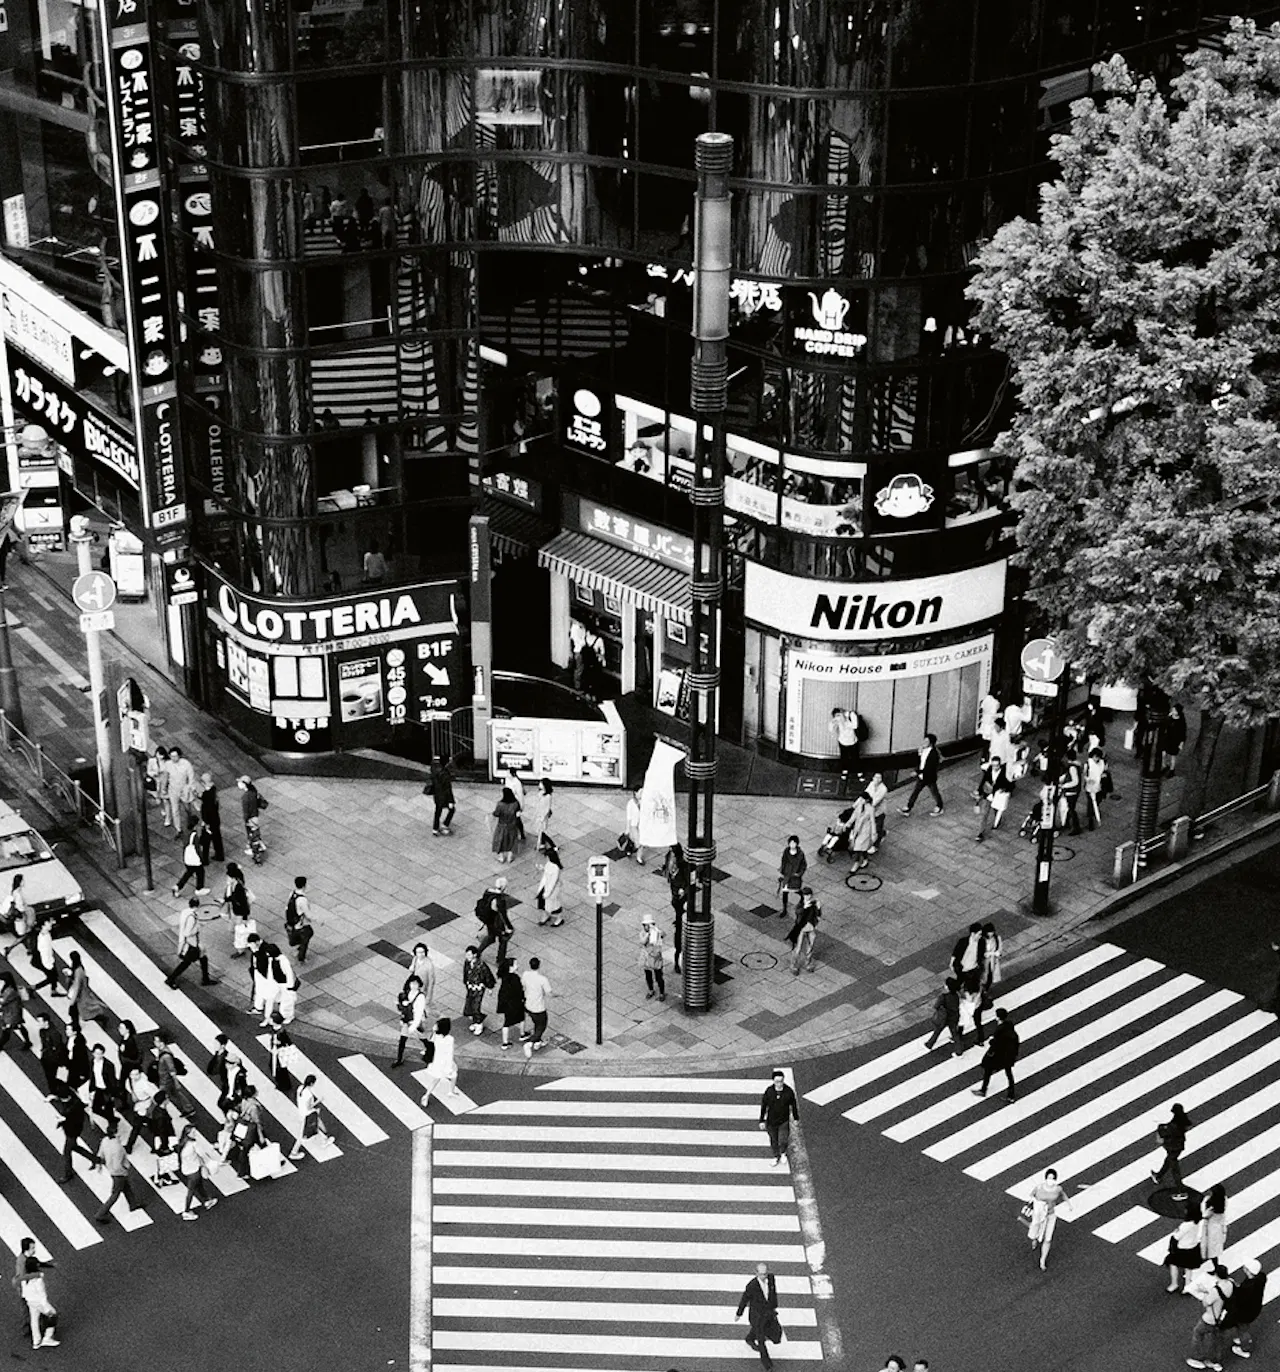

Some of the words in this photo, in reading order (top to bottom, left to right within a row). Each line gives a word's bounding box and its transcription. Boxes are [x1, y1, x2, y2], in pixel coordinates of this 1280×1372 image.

[119, 76, 134, 148] レストラン
[131, 70, 152, 144] 不二家
[135, 233, 165, 344] 不二家
[794, 327, 832, 342] HAND
[834, 331, 867, 346] DRIP
[805, 341, 855, 357] COFFEE
[14, 368, 78, 433] カラオケ
[157, 422, 177, 505] LOTTERIA
[158, 507, 180, 524] B1F
[238, 594, 421, 641] LOTTERIA
[810, 594, 943, 630] Nikon
[417, 640, 453, 660] B1F
[912, 653, 951, 669] SUKIYA
[954, 642, 990, 661] CAMERA
[387, 666, 406, 681] 45
[794, 659, 834, 673] Nikon
[839, 663, 883, 674] House
[388, 704, 406, 719] 10
